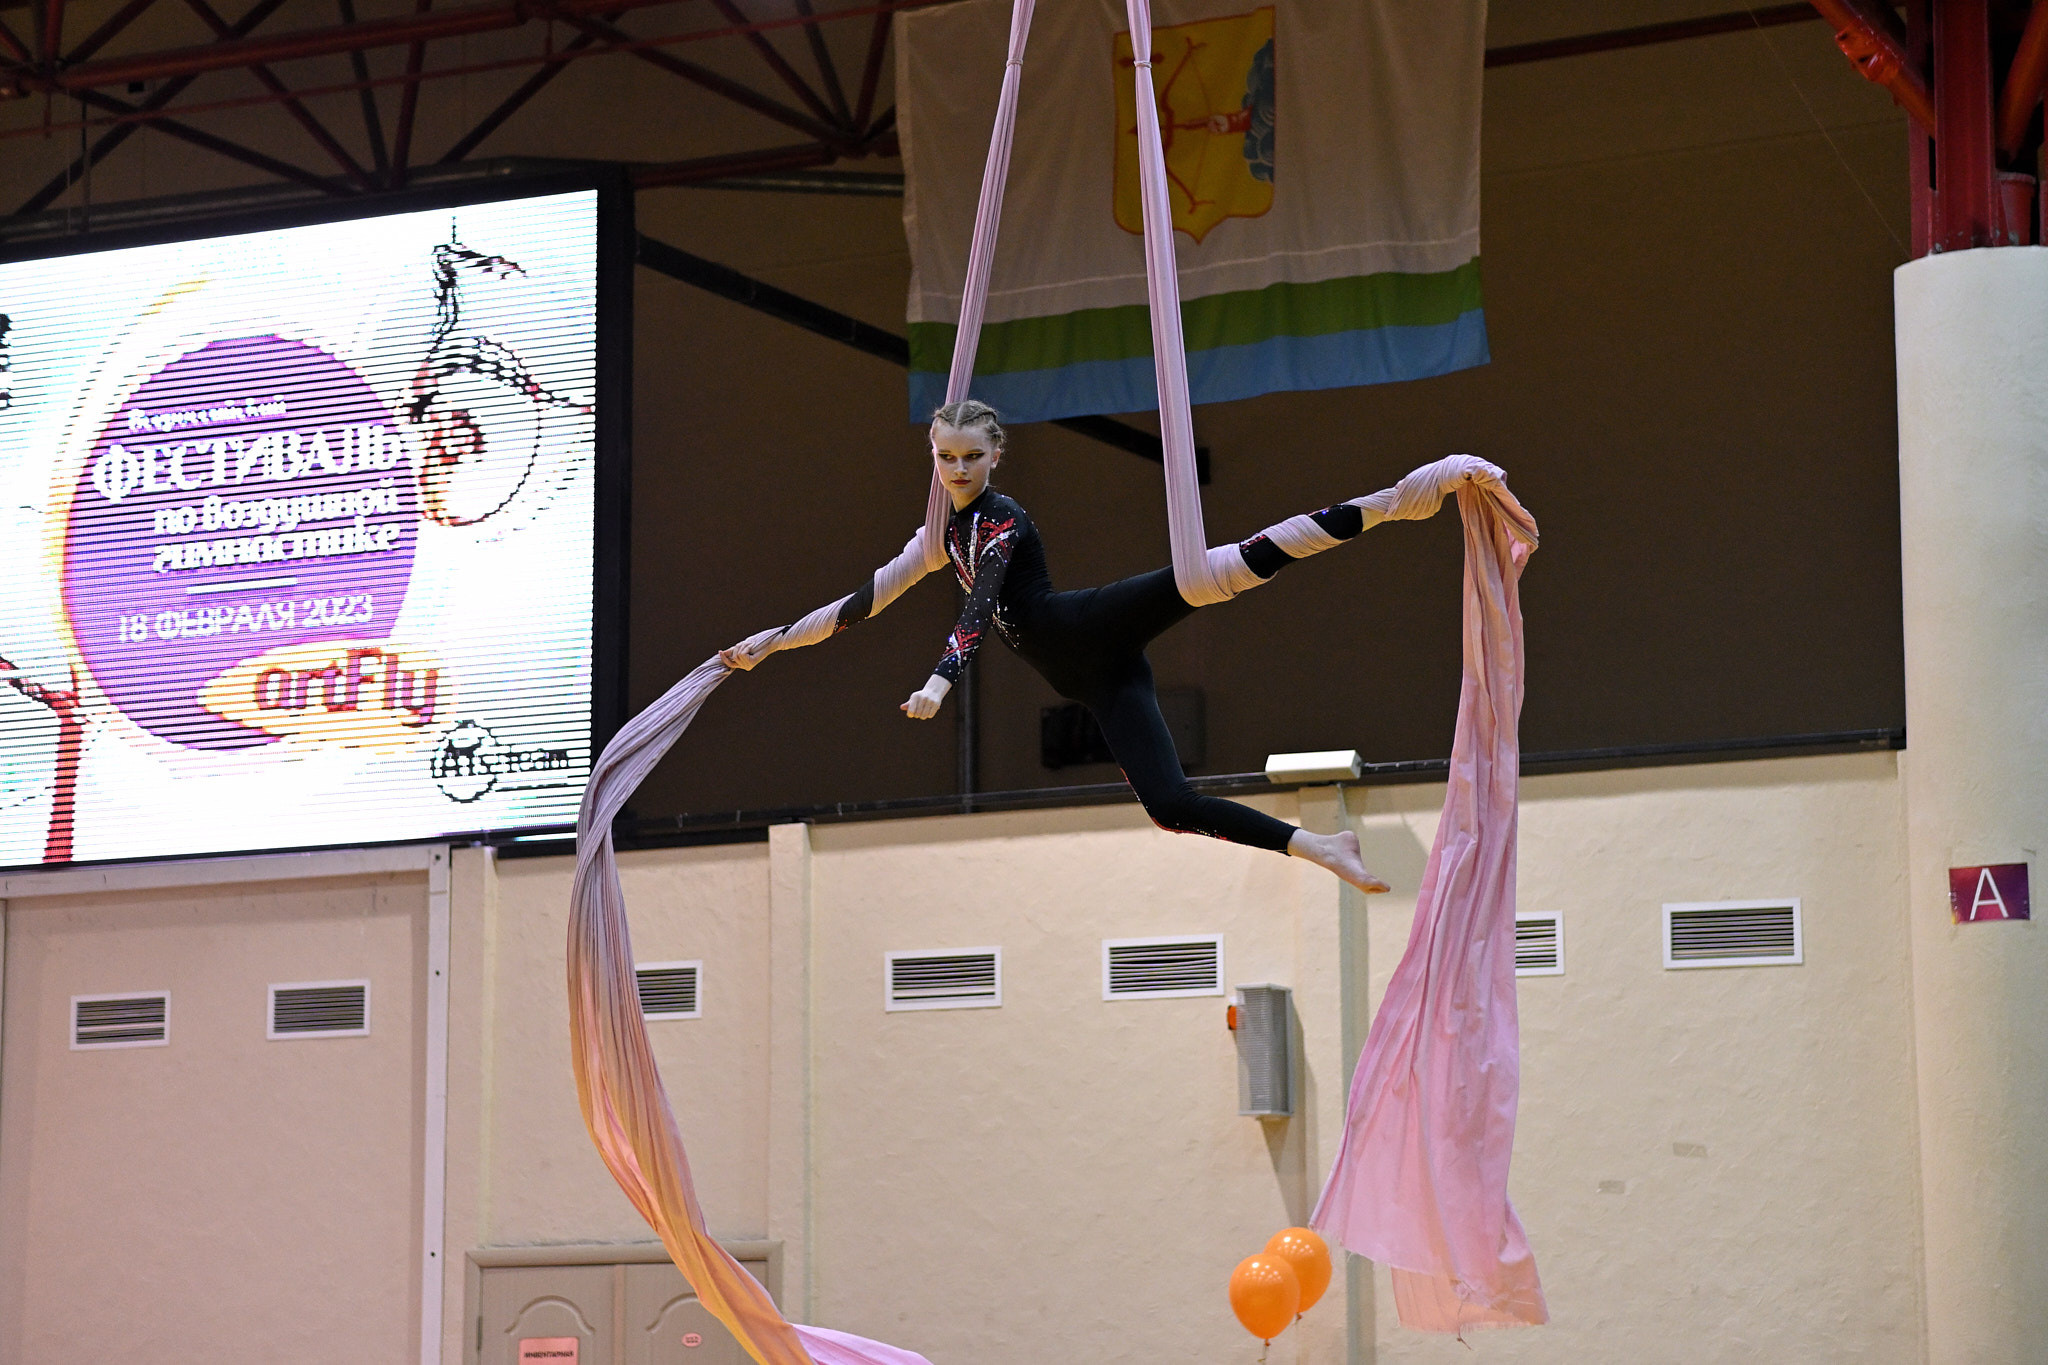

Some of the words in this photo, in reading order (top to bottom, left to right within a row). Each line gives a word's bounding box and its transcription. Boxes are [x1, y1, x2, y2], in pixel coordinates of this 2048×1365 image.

[92, 424, 402, 504] ФЕСТИВАЛЬ
[154, 506, 198, 535] по
[203, 478, 400, 534] воздушной
[153, 515, 401, 574] гимнастике
[119, 614, 148, 643] 18
[155, 600, 296, 639] ФЕВРАЛЯ
[303, 594, 373, 628] 2023
[254, 647, 439, 729] artFly
